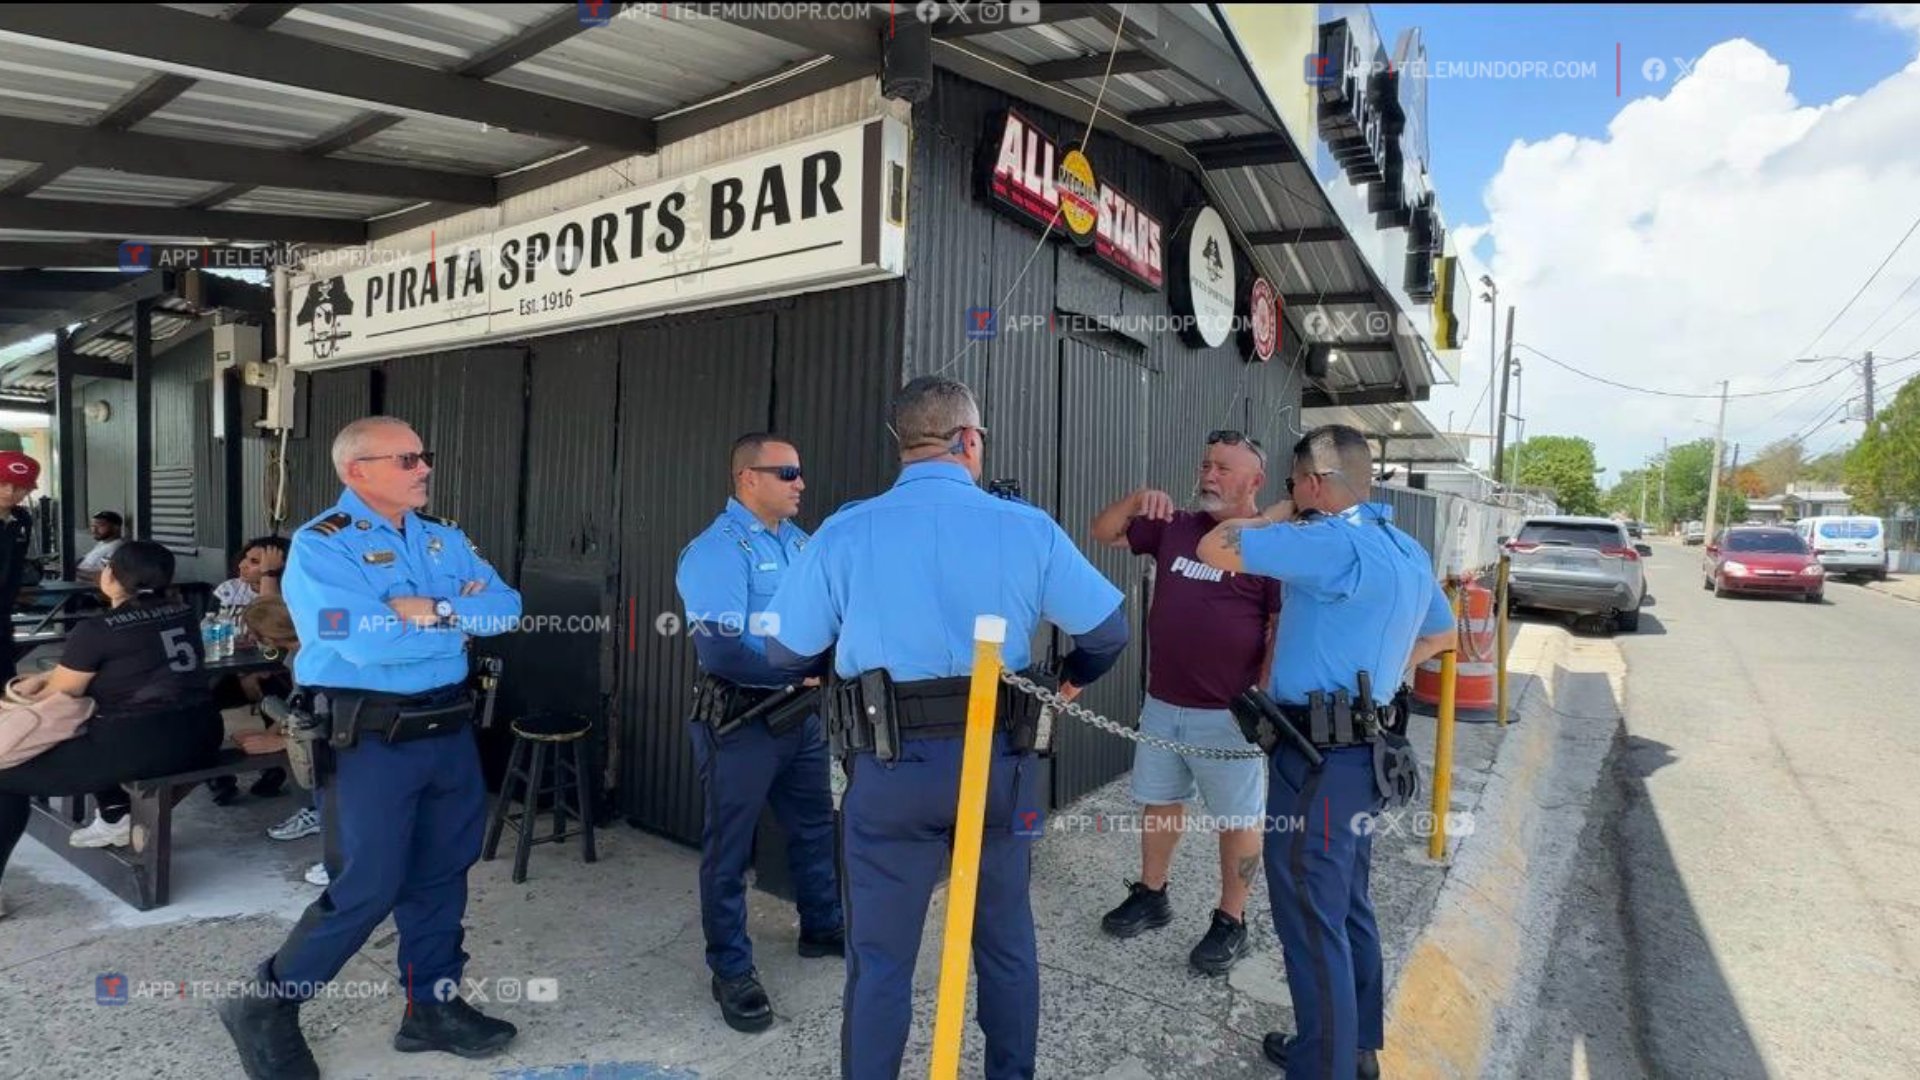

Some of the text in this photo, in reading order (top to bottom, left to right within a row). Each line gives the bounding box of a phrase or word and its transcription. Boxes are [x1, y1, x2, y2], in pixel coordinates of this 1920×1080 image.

[994, 114, 1060, 207] ALL
[366, 150, 843, 317] PIRATA SPORTS BAR
[1097, 183, 1162, 272] STARS
[541, 288, 573, 312] 1916
[1170, 556, 1223, 582] PUMA
[159, 627, 198, 671] 5
